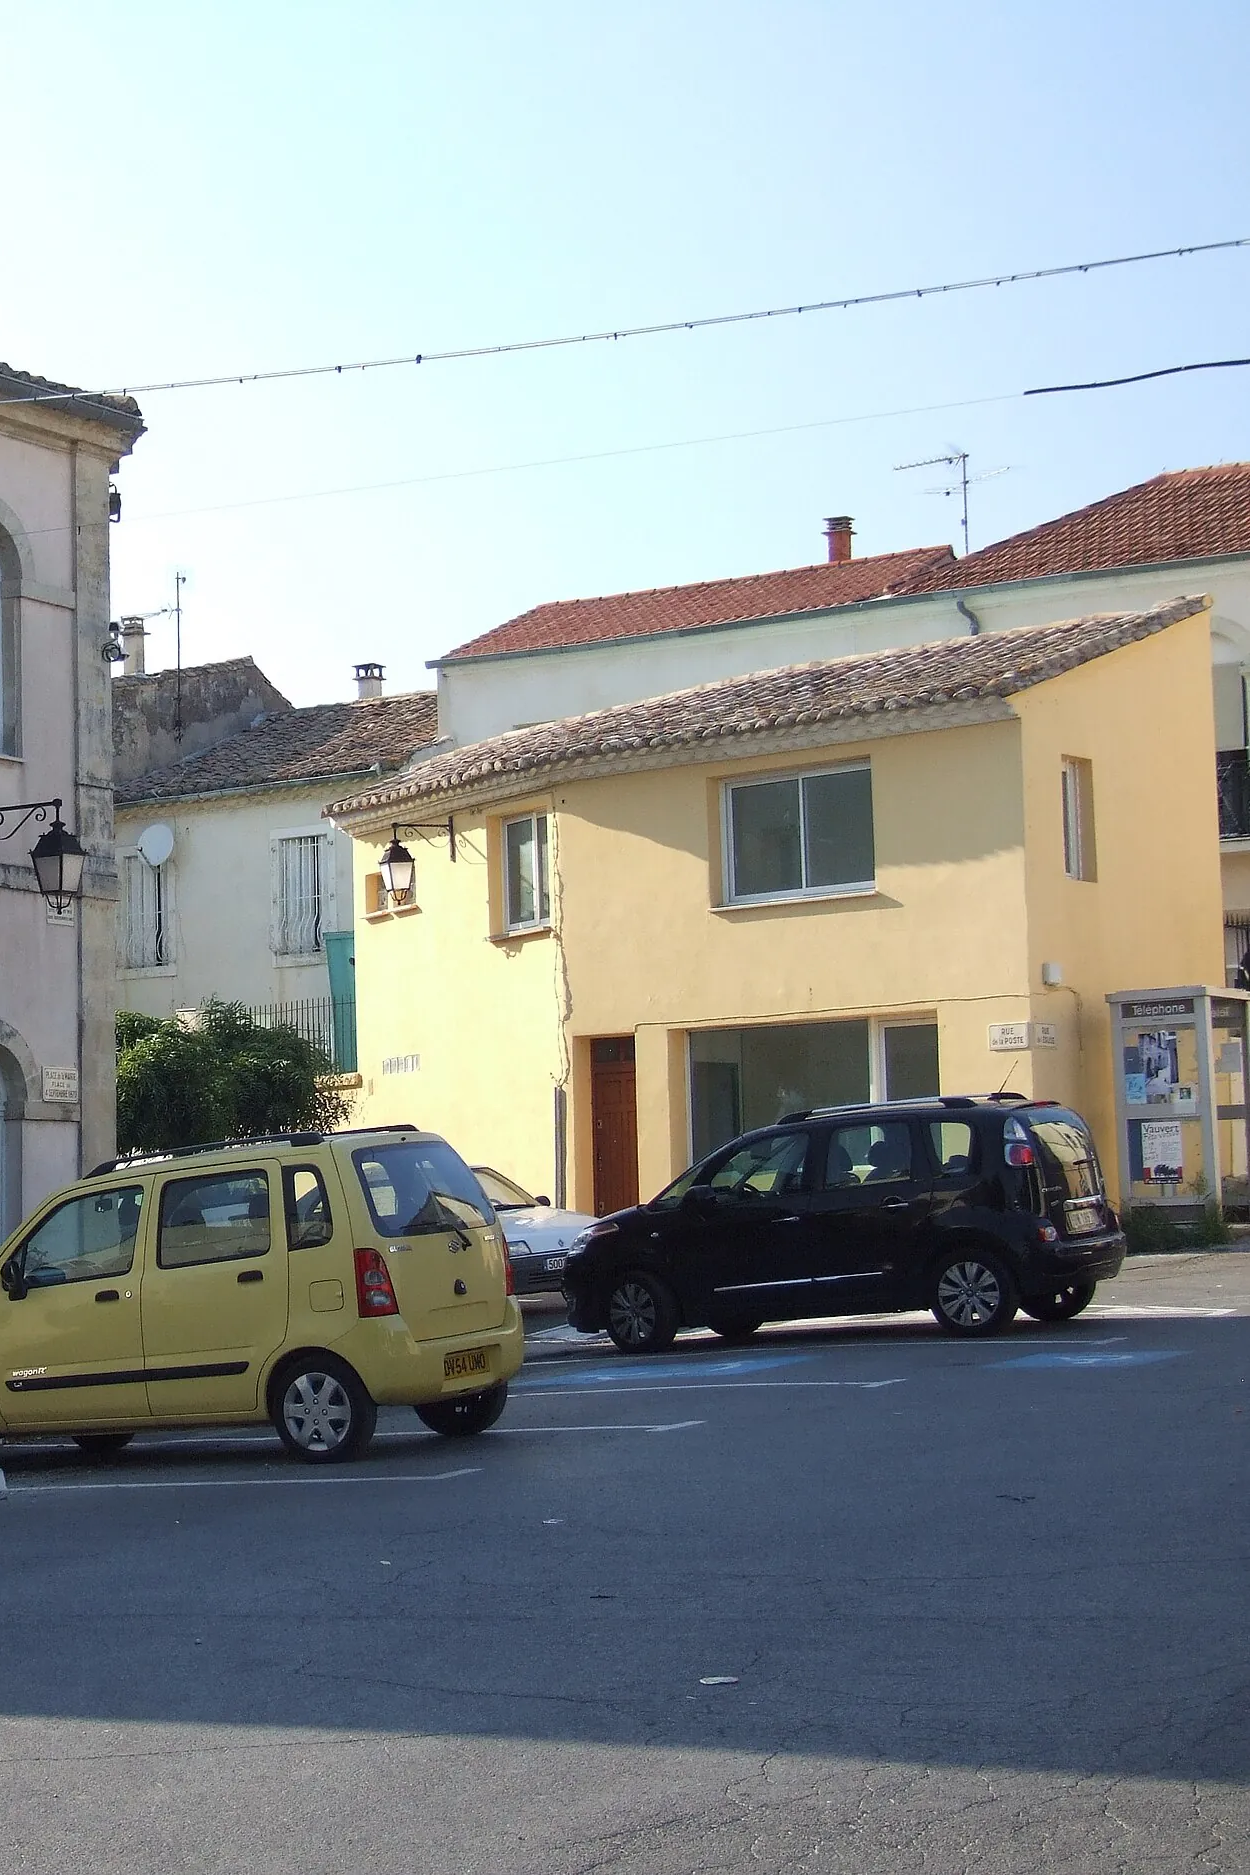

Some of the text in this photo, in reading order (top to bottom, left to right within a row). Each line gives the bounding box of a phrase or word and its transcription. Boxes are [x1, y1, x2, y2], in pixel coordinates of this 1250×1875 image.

[1131, 1003, 1186, 1016] Téléphone
[1001, 1027, 1015, 1035] RUE
[1004, 1036, 1024, 1045] POSTE
[1142, 1124, 1180, 1134] Vauvert
[548, 1258, 565, 1270] 500
